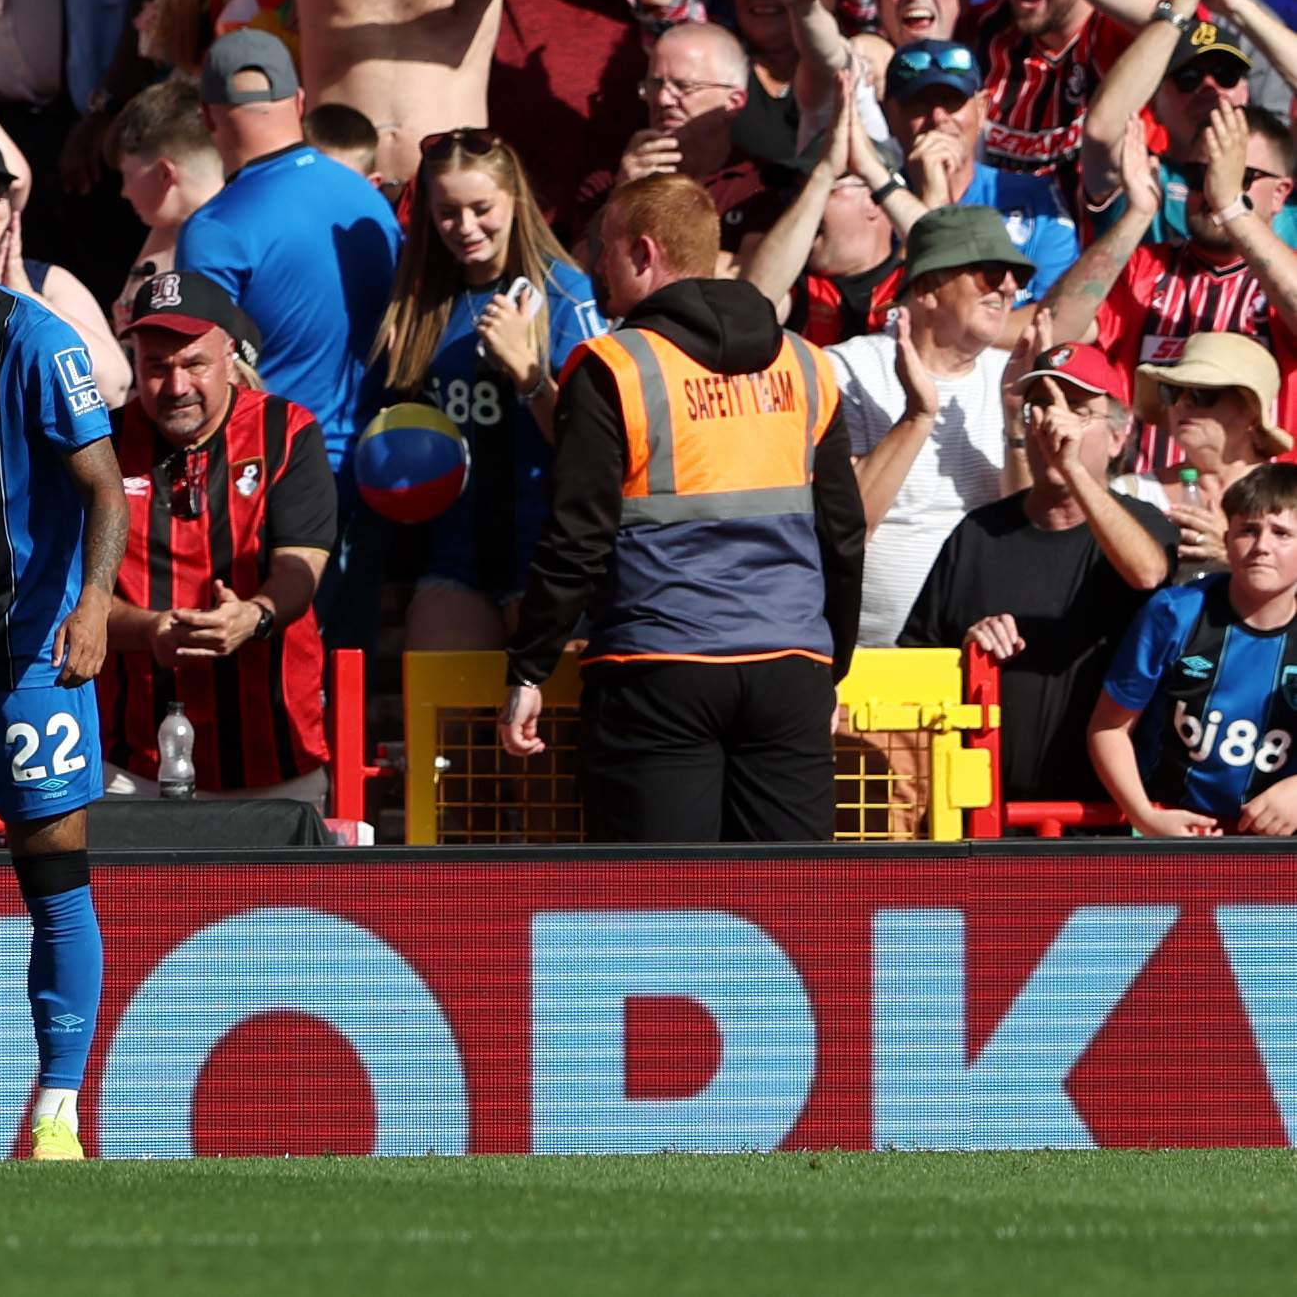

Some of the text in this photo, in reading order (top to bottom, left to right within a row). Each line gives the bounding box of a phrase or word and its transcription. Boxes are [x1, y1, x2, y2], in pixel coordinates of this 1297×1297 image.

[68, 388, 104, 412] LEO
[684, 373, 743, 421] SAFETY
[6, 712, 86, 782] 22
[1173, 693, 1292, 771] bj88
